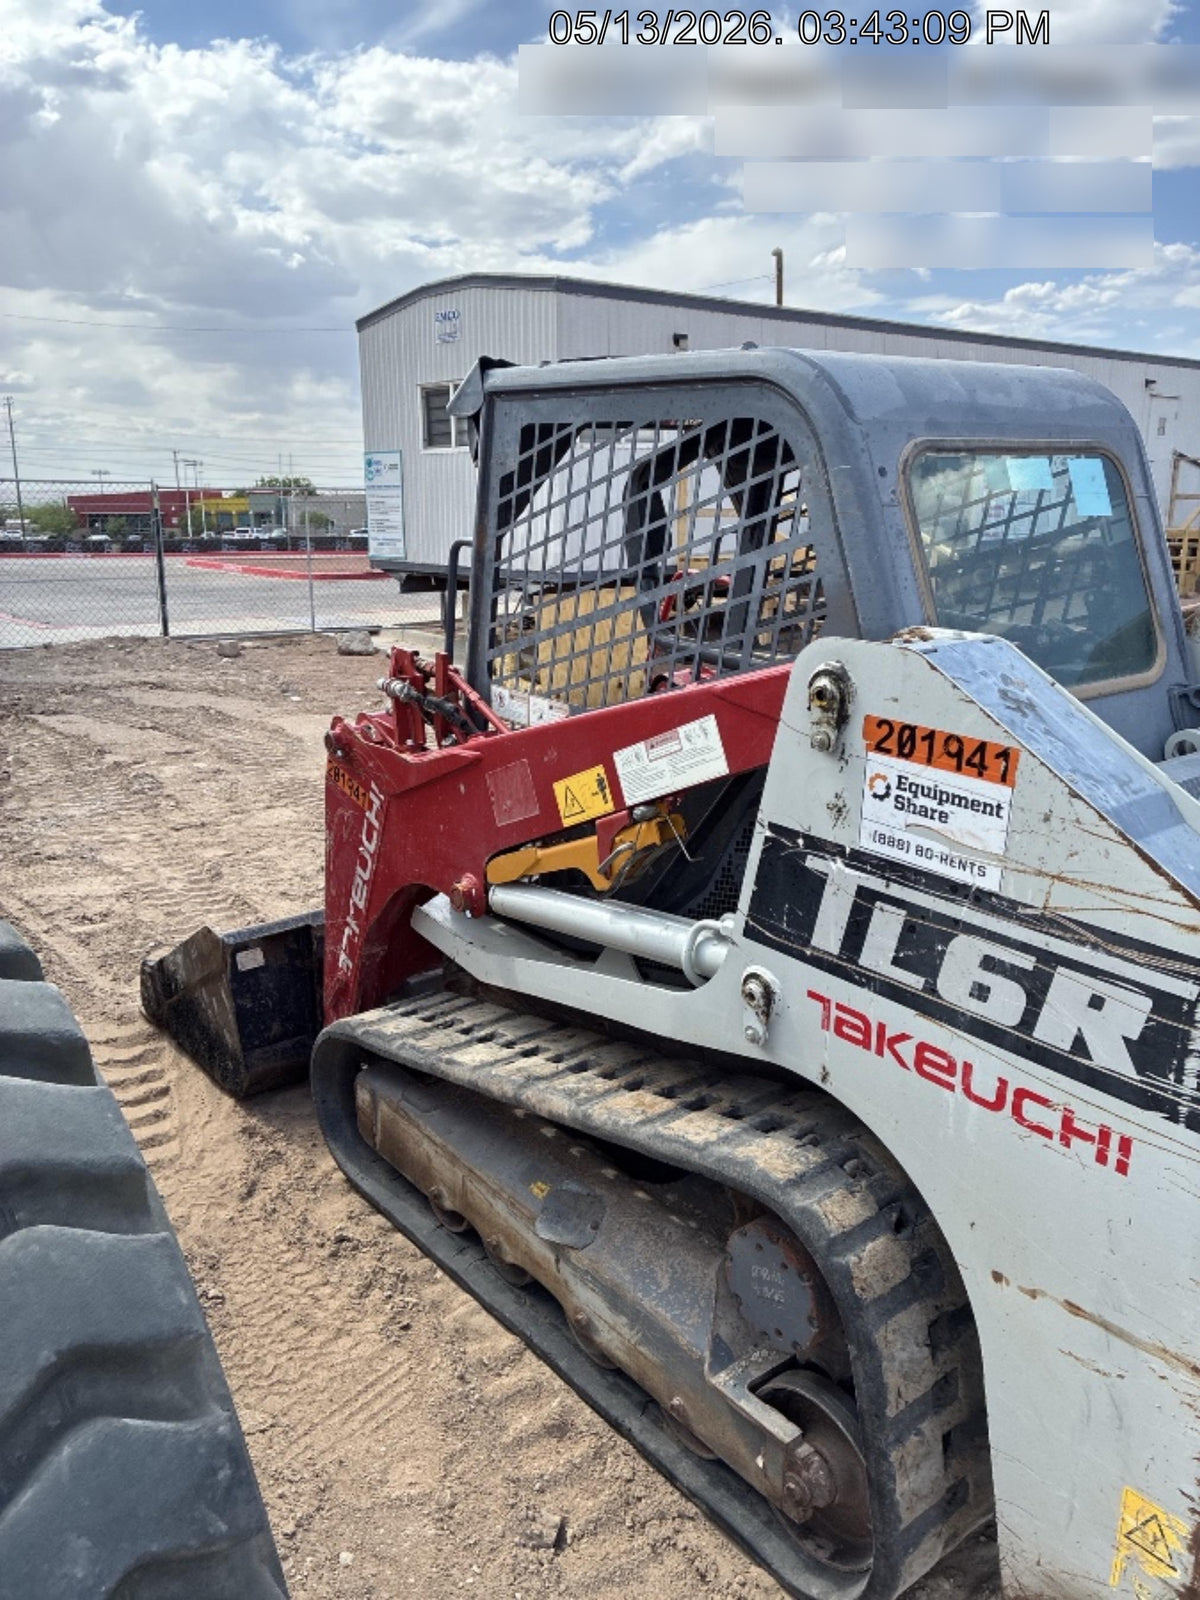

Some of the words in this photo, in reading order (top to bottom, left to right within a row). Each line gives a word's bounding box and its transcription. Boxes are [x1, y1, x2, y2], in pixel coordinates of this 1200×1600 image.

[873, 719, 1012, 783] 201941
[893, 794, 950, 824] Share
[895, 775, 1005, 819] Equipment
[872, 829, 911, 853] (888)
[805, 855, 1154, 1076] TL6R
